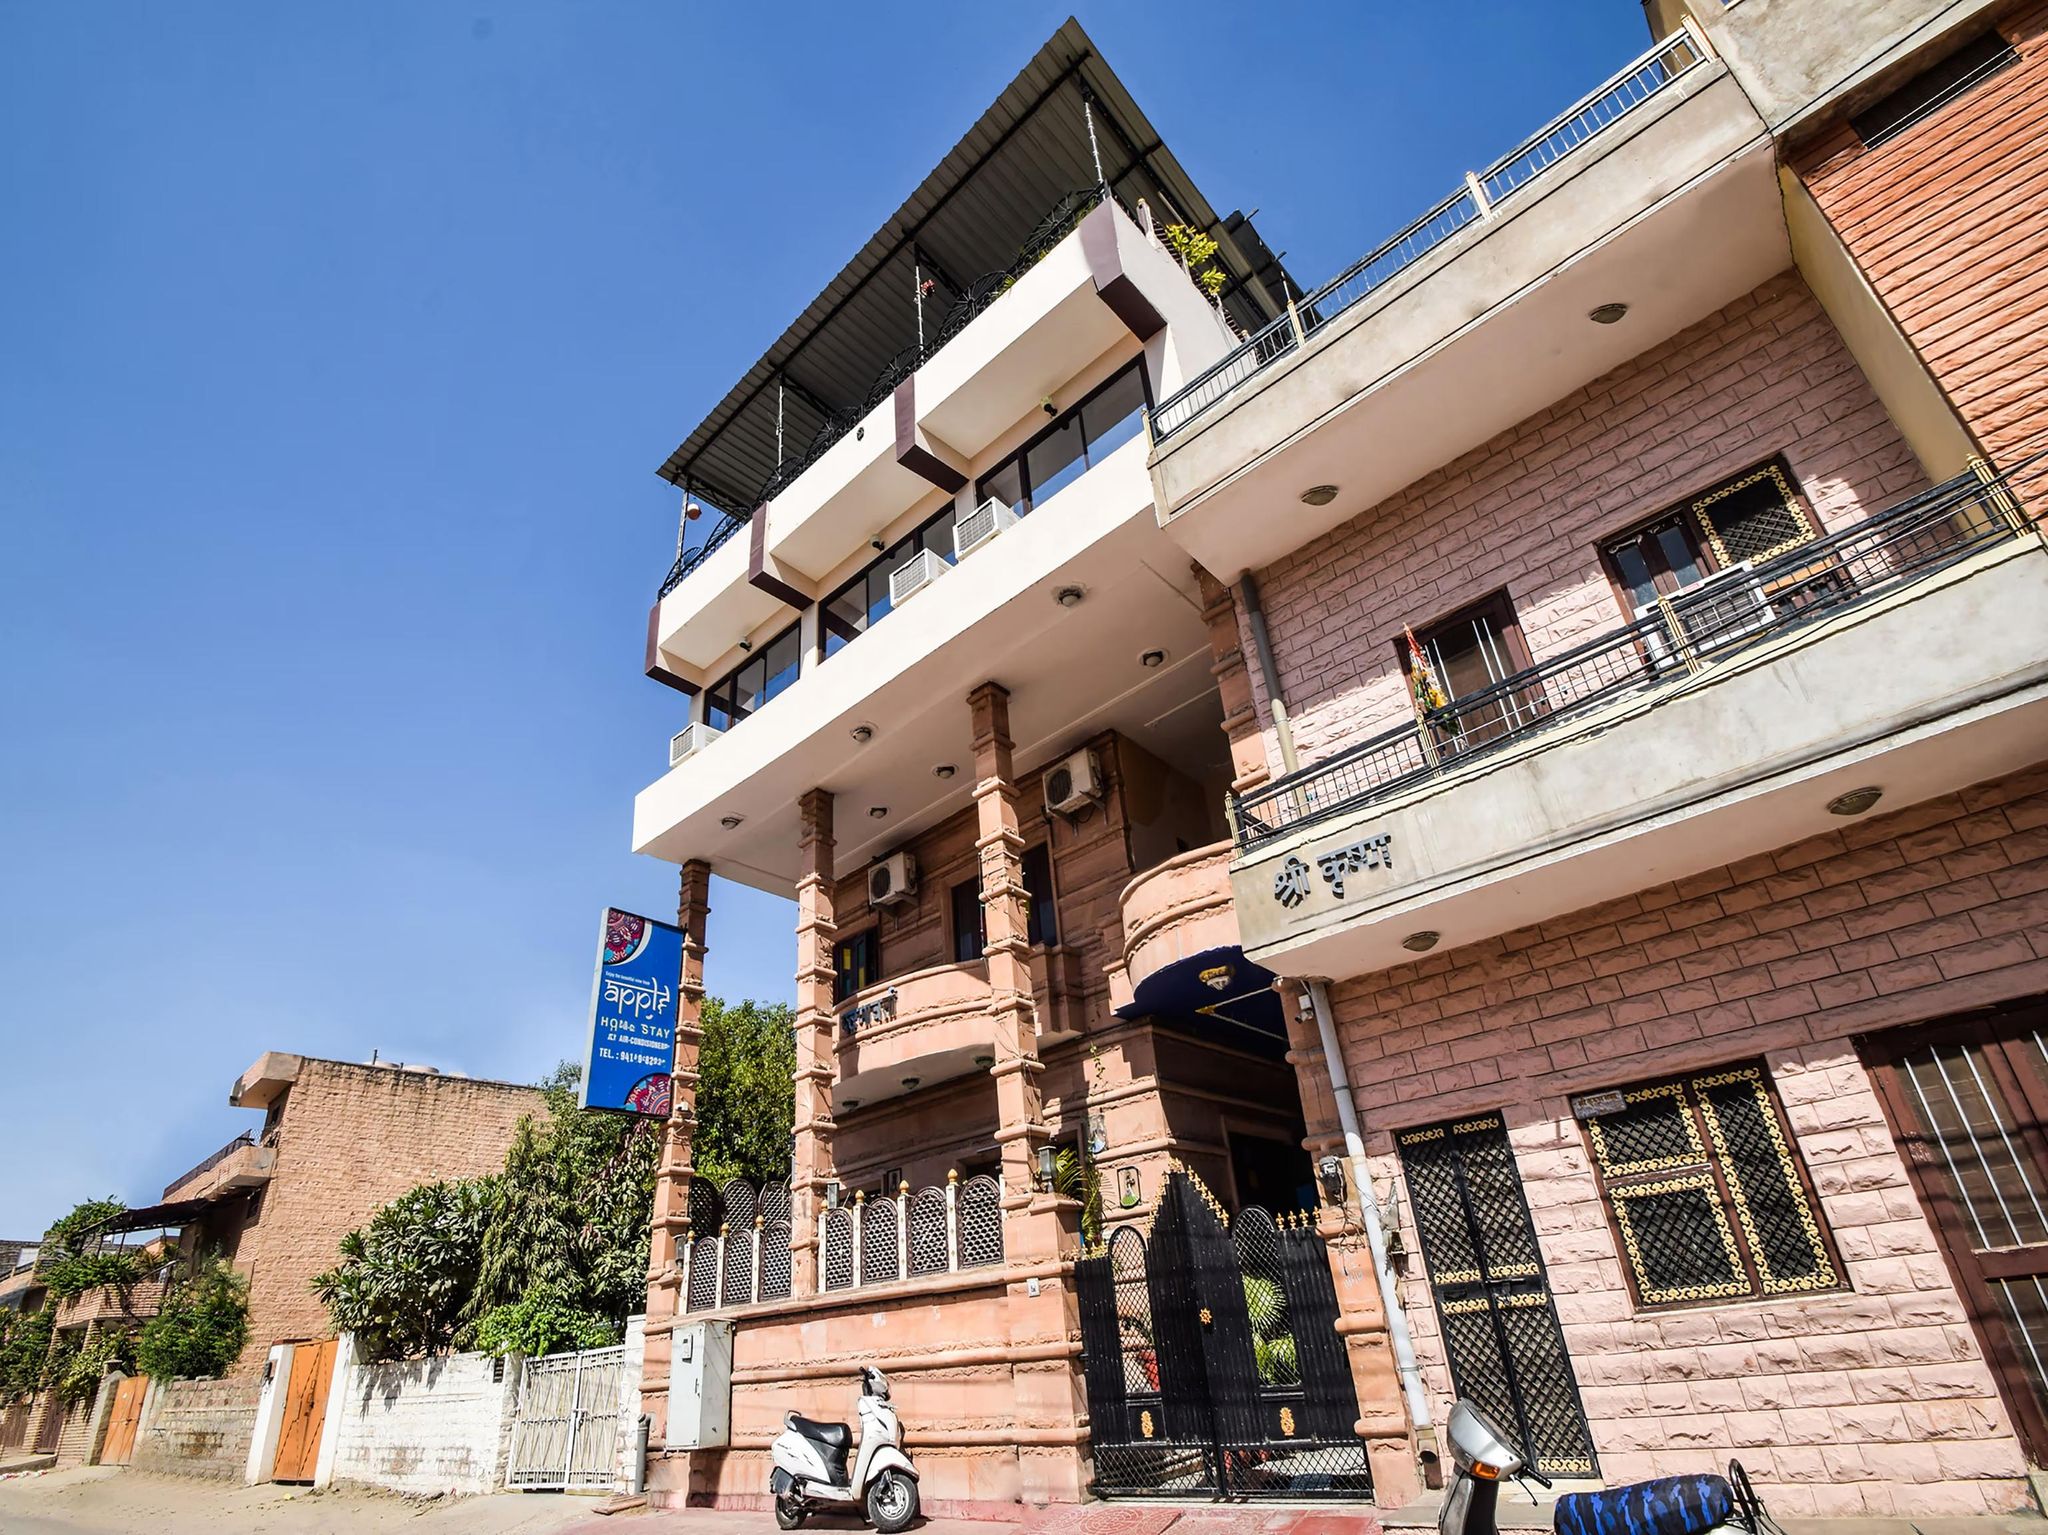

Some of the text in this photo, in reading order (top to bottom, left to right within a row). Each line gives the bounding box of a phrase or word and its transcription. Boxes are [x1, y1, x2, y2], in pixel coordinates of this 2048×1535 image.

[1274, 832, 1392, 907] श्री कृष्ण
[641, 1023, 670, 1039] STAY
